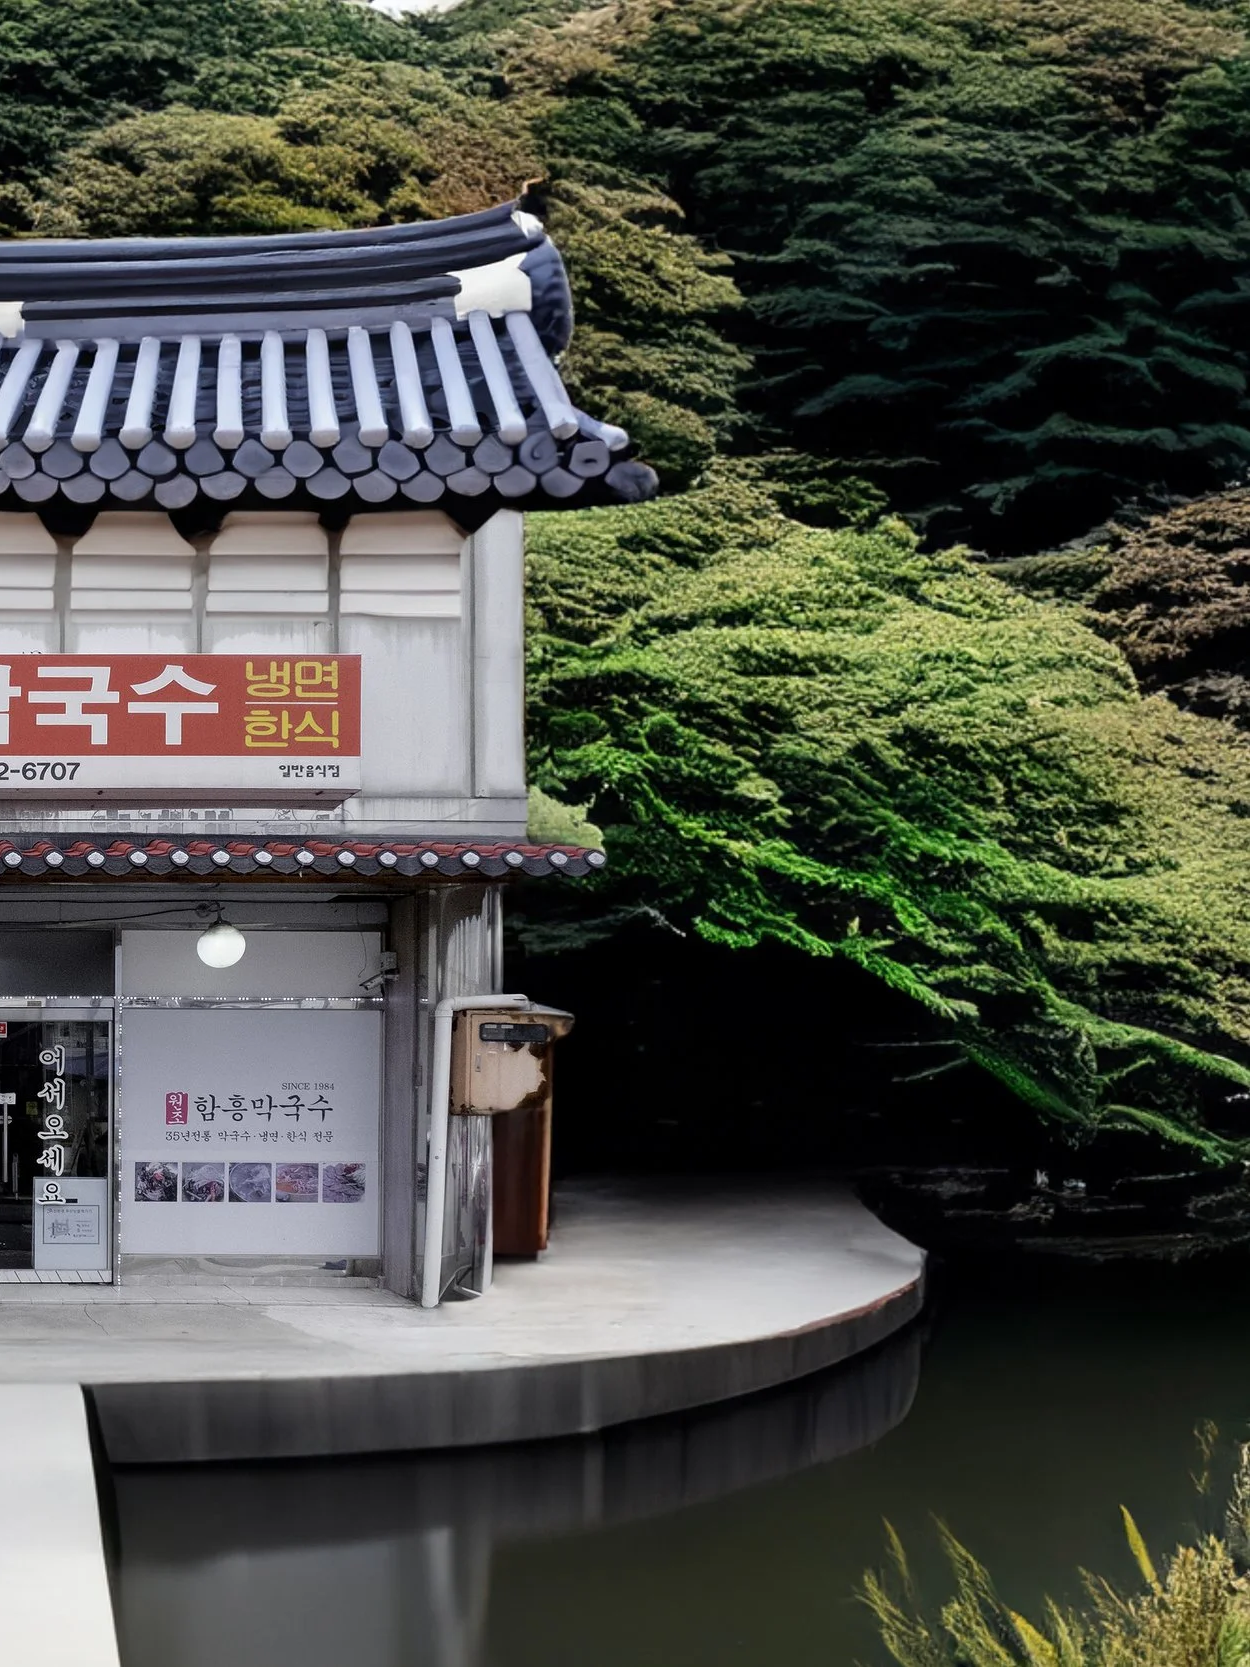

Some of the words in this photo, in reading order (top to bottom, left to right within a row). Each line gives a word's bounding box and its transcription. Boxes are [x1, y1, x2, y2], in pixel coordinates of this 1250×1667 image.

[245, 660, 339, 698] 냉면
[243, 709, 340, 749] 한식
[278, 764, 340, 778] 일반음식점
[281, 1082, 310, 1091] SINCE
[313, 1082, 335, 1091] 1984
[36, 1044, 69, 1206] 어서오세요
[167, 1093, 185, 1125] 원조
[193, 1094, 334, 1123] 함흥막국수
[165, 1131, 212, 1142] 35년전통
[313, 1131, 334, 1142] 전문
